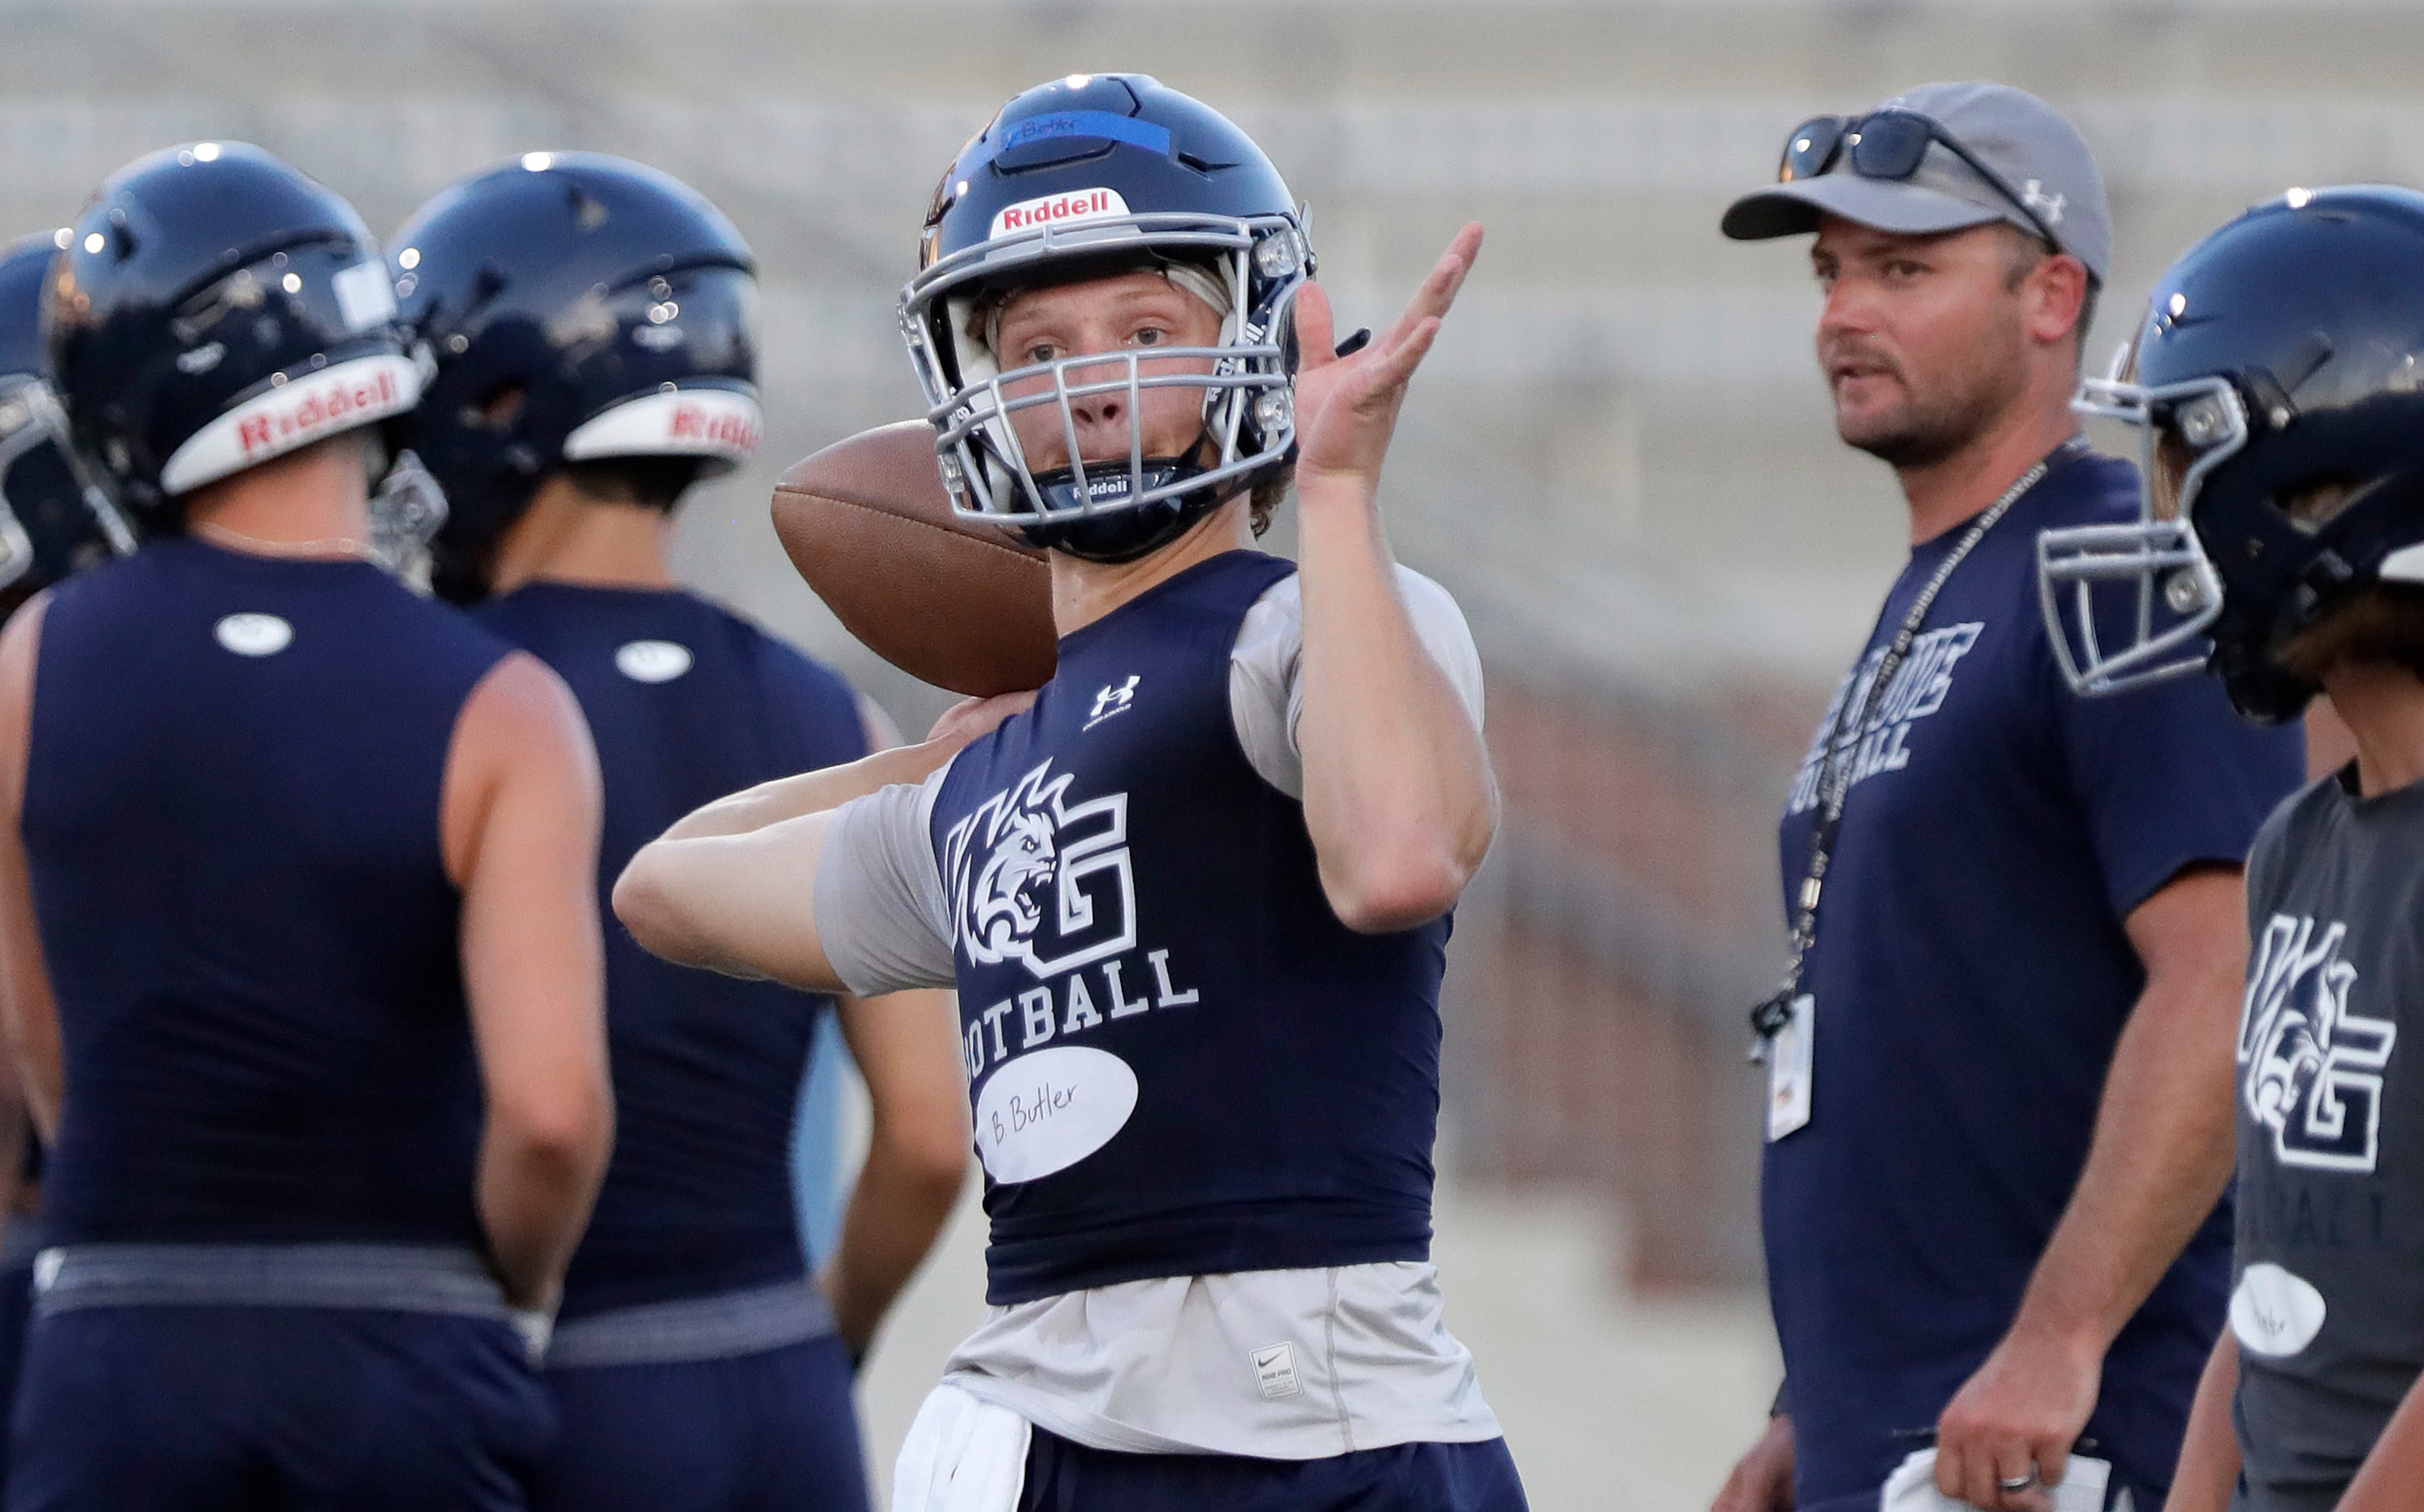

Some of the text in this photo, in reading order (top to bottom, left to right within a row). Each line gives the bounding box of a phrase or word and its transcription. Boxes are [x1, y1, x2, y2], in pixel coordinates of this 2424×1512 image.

[1003, 192, 1109, 229] Riddell
[1073, 480, 1128, 500] Rddell
[1010, 1081, 1079, 1134] Butler
